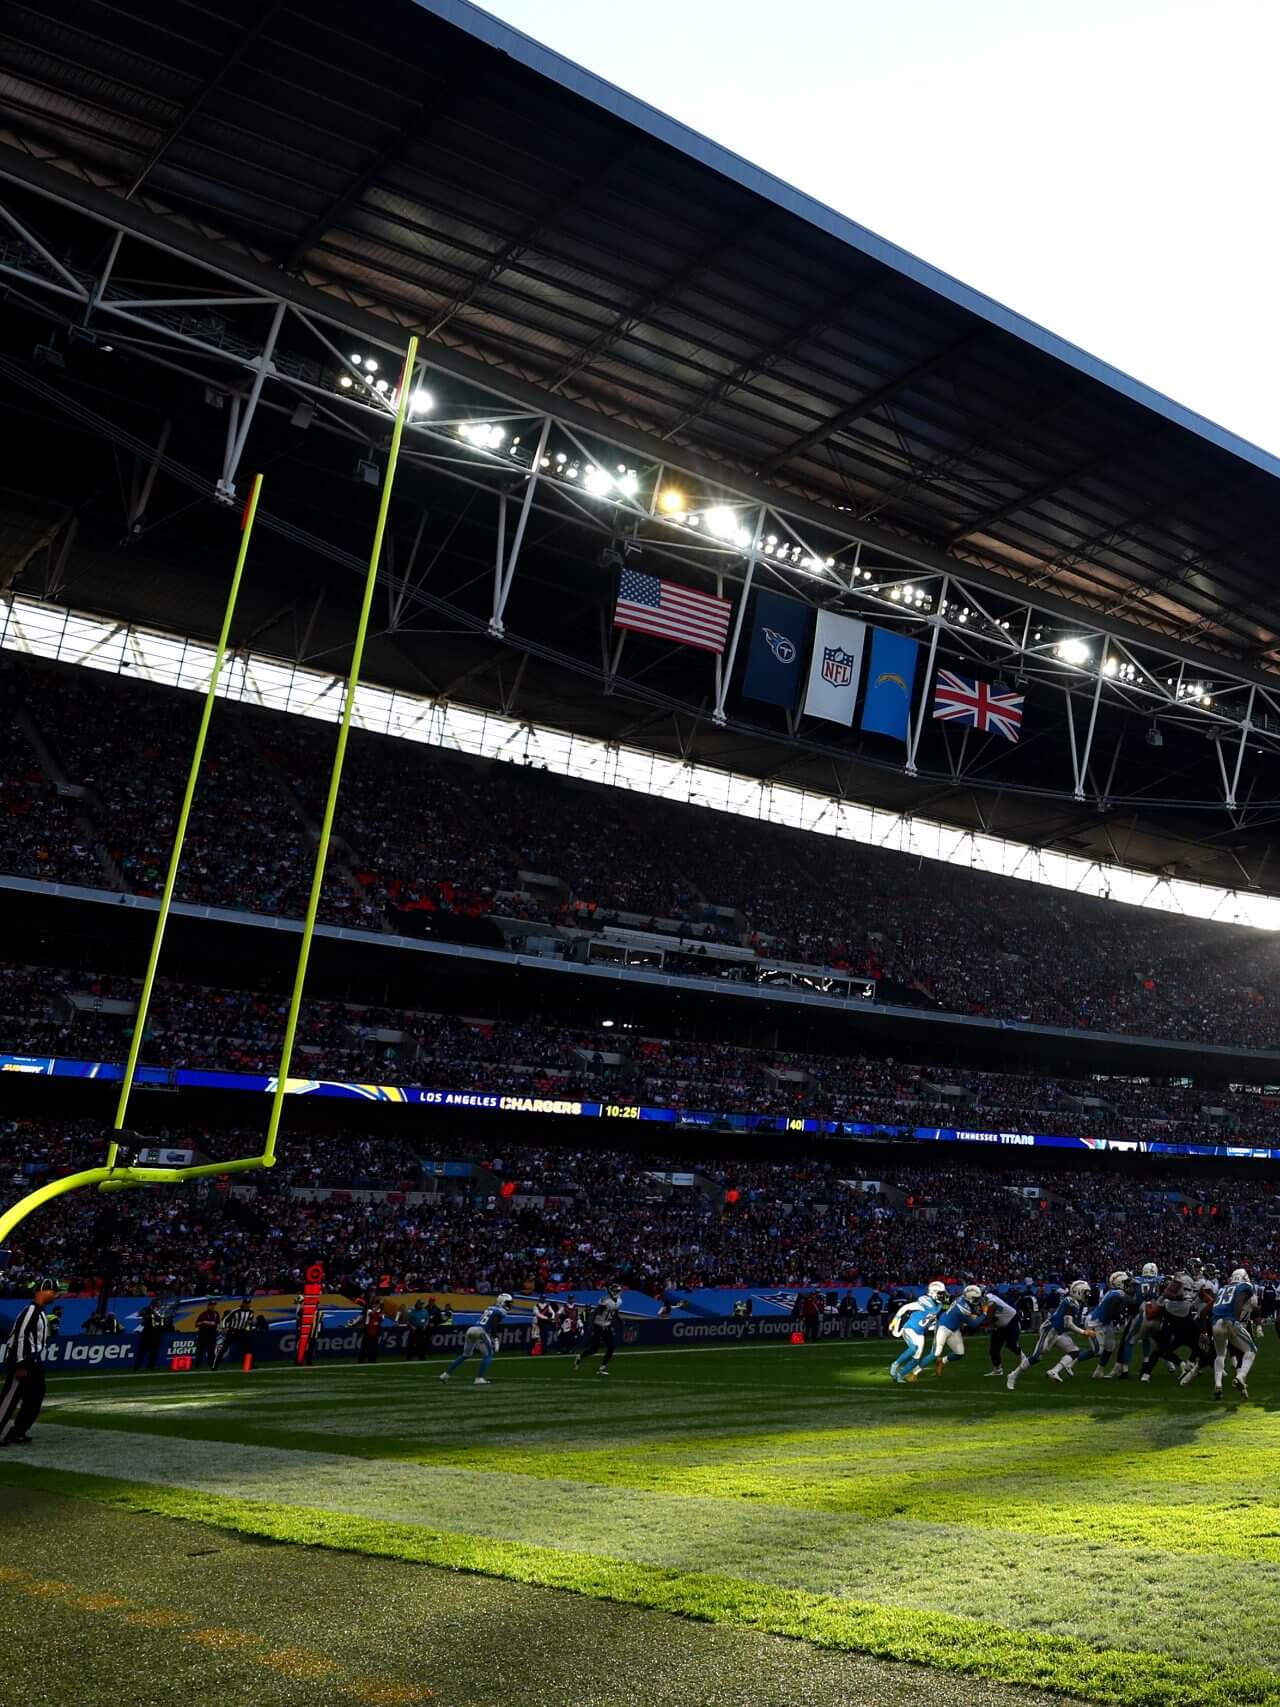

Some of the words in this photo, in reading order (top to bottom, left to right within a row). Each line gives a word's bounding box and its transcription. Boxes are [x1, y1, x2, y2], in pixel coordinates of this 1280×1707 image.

[825, 661, 849, 683] NFL
[420, 1091, 442, 1103] LOS
[445, 1093, 497, 1108] ANGELES
[500, 1096, 582, 1116] CHARGERS
[606, 1104, 638, 1119] 10:25
[788, 1118, 803, 1131] 40
[956, 1130, 998, 1142] TENNESSEE
[1000, 1132, 1034, 1146] TITANS
[672, 1318, 755, 1339] Gameday's
[758, 1314, 816, 1335] favorit
[64, 1340, 135, 1364] lager.
[167, 1346, 198, 1355] LIGHT
[172, 1340, 195, 1348] BUD
